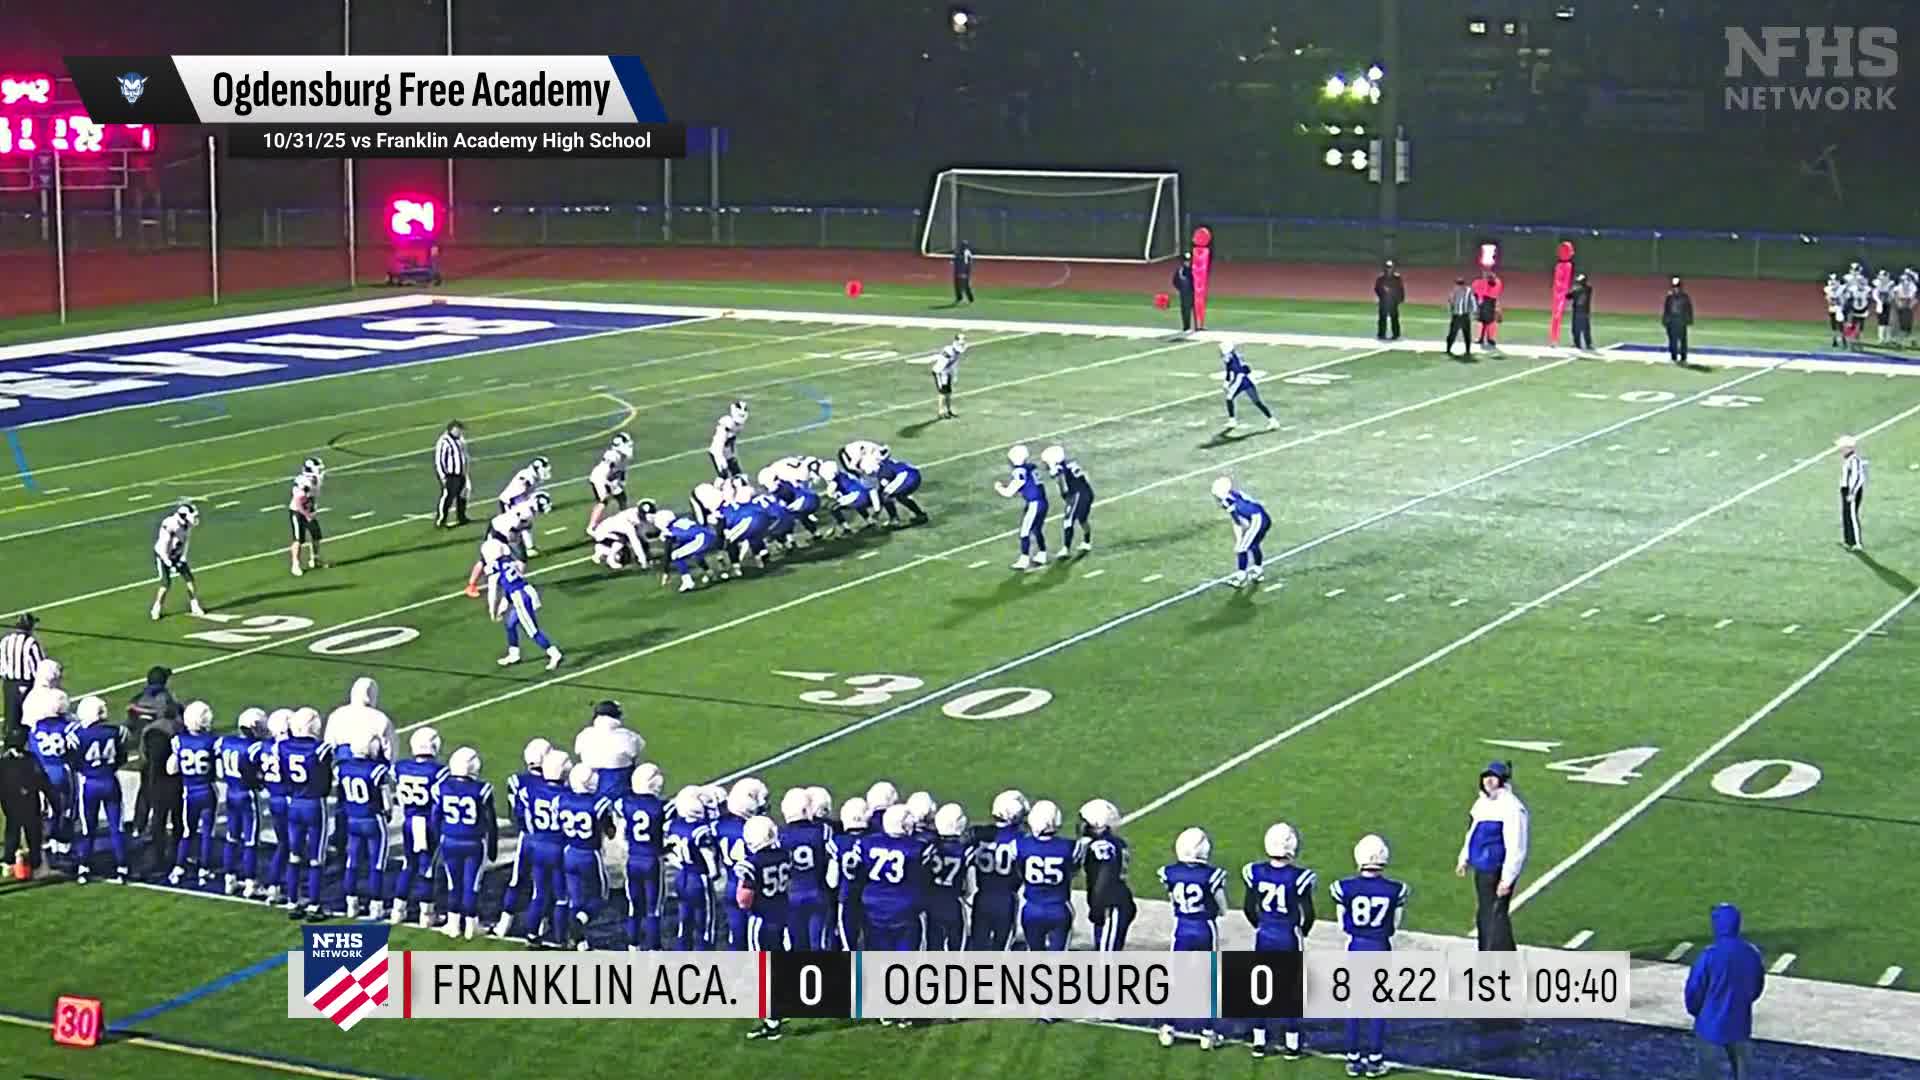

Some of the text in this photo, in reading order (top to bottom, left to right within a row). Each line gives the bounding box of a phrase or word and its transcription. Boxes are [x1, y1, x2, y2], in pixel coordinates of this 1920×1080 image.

[799, 674, 1054, 721] 30
[84, 738, 117, 767] 44
[180, 748, 210, 775] 26
[288, 754, 308, 783] 5
[1545, 746, 1823, 799] 40
[341, 775, 369, 804] 10
[398, 774, 430, 806] 55
[442, 794, 477, 825] 53
[632, 810, 651, 841] 2
[868, 847, 905, 884] 73
[1024, 856, 1064, 886] 65
[1172, 882, 1206, 914] 42
[1258, 881, 1288, 914] 71
[1351, 895, 1390, 928] 87
[60, 1004, 93, 1040] 30
